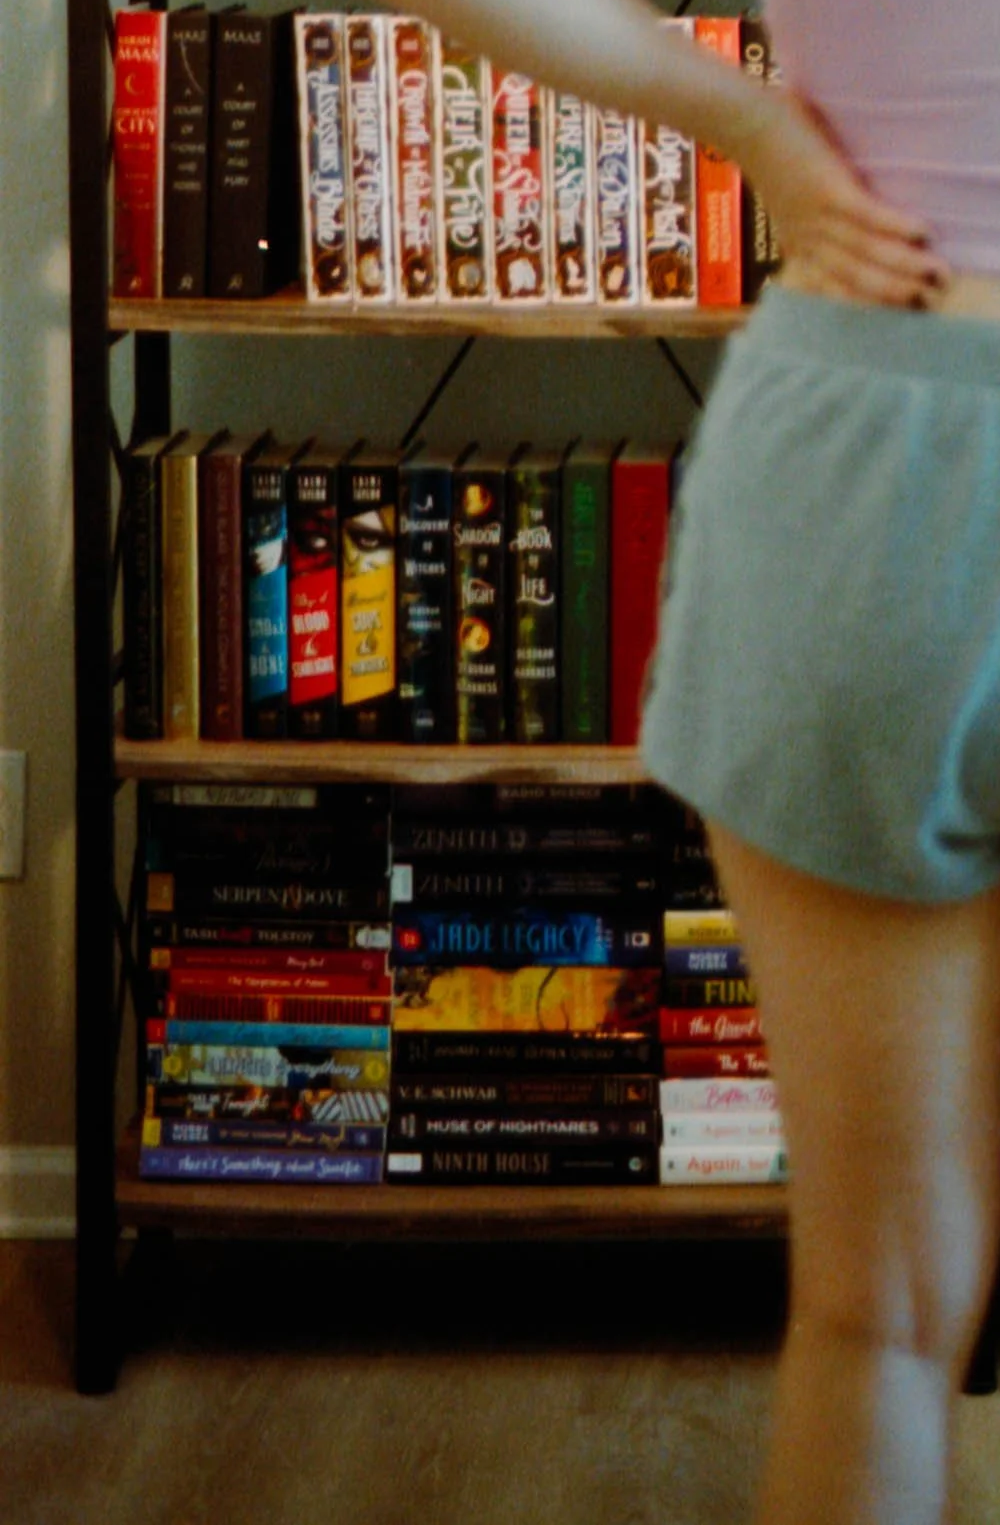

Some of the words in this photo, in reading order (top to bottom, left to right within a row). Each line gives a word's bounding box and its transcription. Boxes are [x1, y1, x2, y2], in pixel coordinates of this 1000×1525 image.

[223, 31, 261, 44] MAAS
[119, 48, 160, 61] MAAS
[222, 100, 255, 111] COURT
[116, 117, 157, 134] CITY
[224, 175, 249, 186] FURY
[302, 886, 349, 909] DOVE
[257, 929, 316, 943] TOLSTOY
[432, 923, 494, 954] JADE
[503, 923, 587, 954] LEGACY
[431, 1085, 497, 1101] SCHWAB
[427, 1119, 470, 1135] MUSE
[474, 1119, 495, 1135] OF
[499, 1119, 600, 1135] NIGHTMARES
[432, 1151, 489, 1173] NINTH
[495, 1151, 551, 1173] HOUSE
